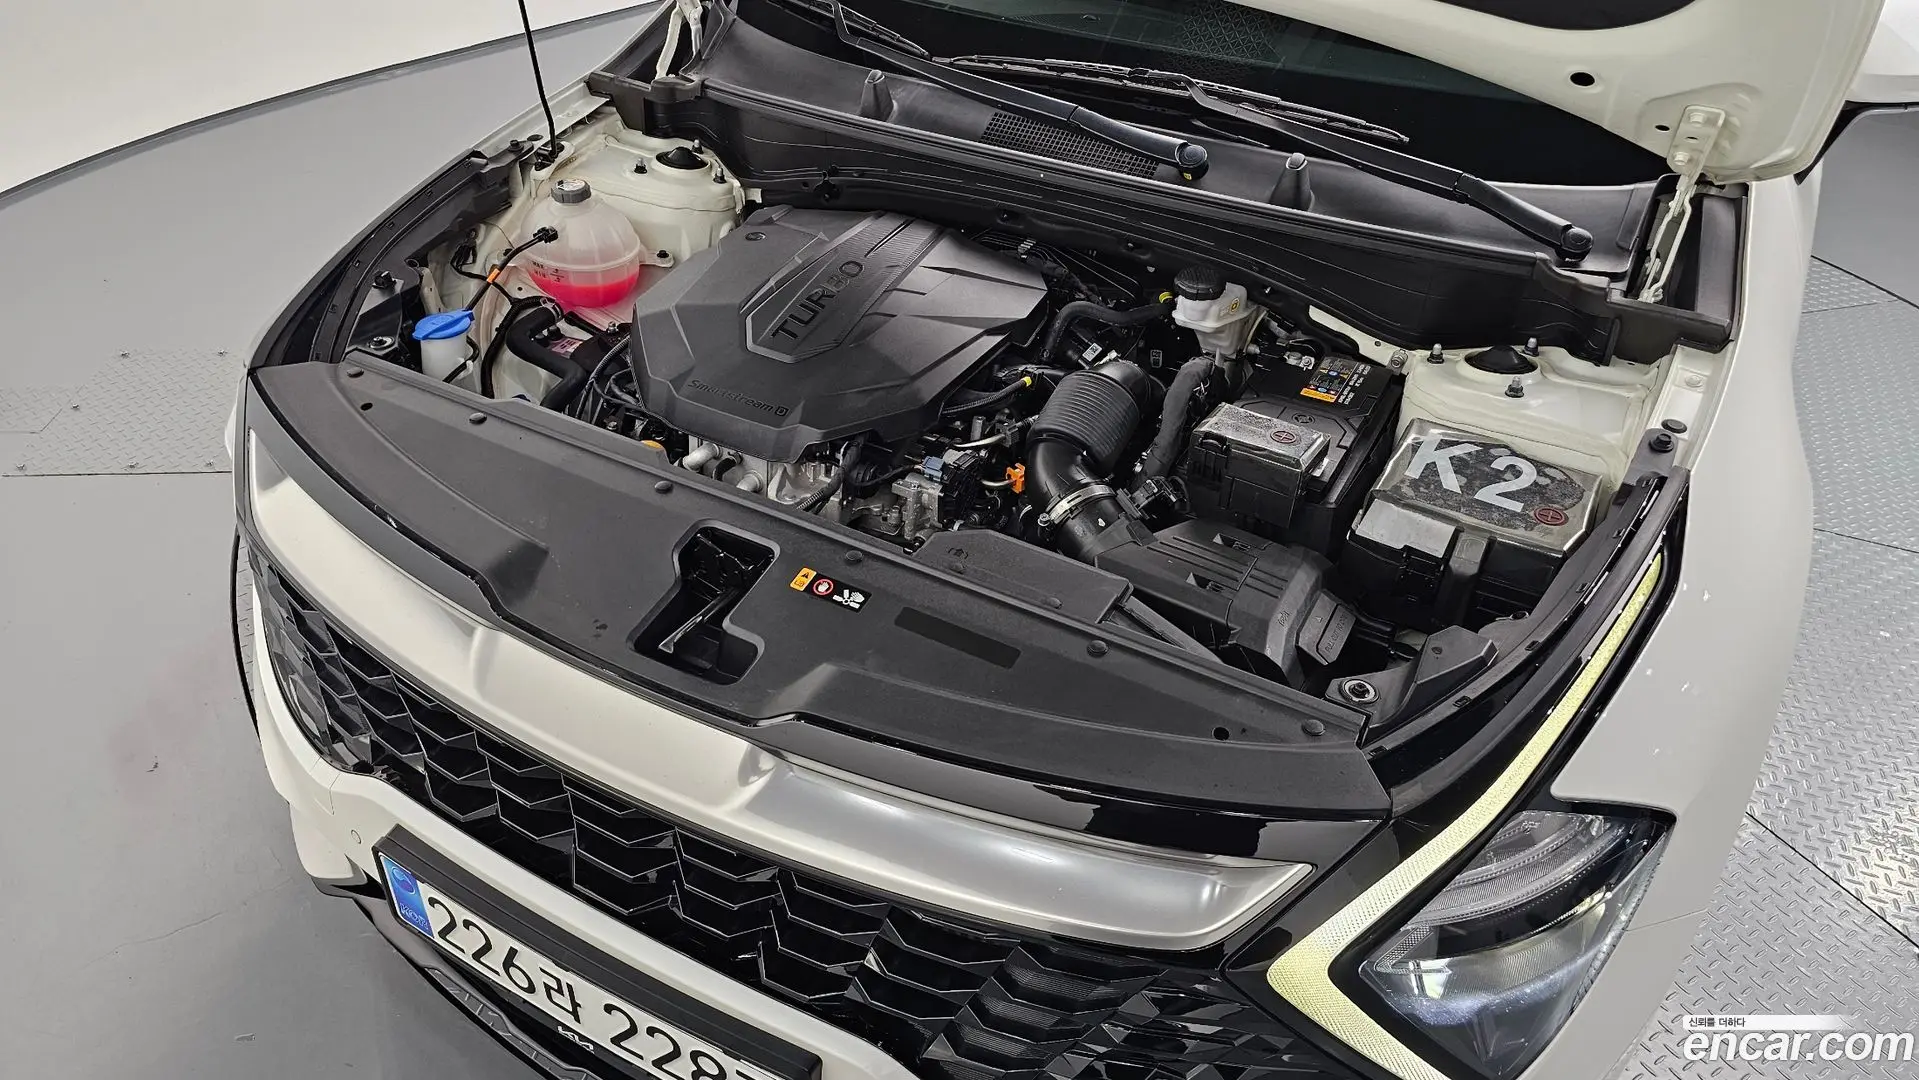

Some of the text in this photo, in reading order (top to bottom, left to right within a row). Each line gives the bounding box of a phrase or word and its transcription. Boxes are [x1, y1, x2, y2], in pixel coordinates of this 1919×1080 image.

[770, 260, 865, 340] TURBO
[687, 378, 774, 413] Smartstream
[1404, 433, 1538, 513] K2
[427, 895, 758, 1080] 226라 228
